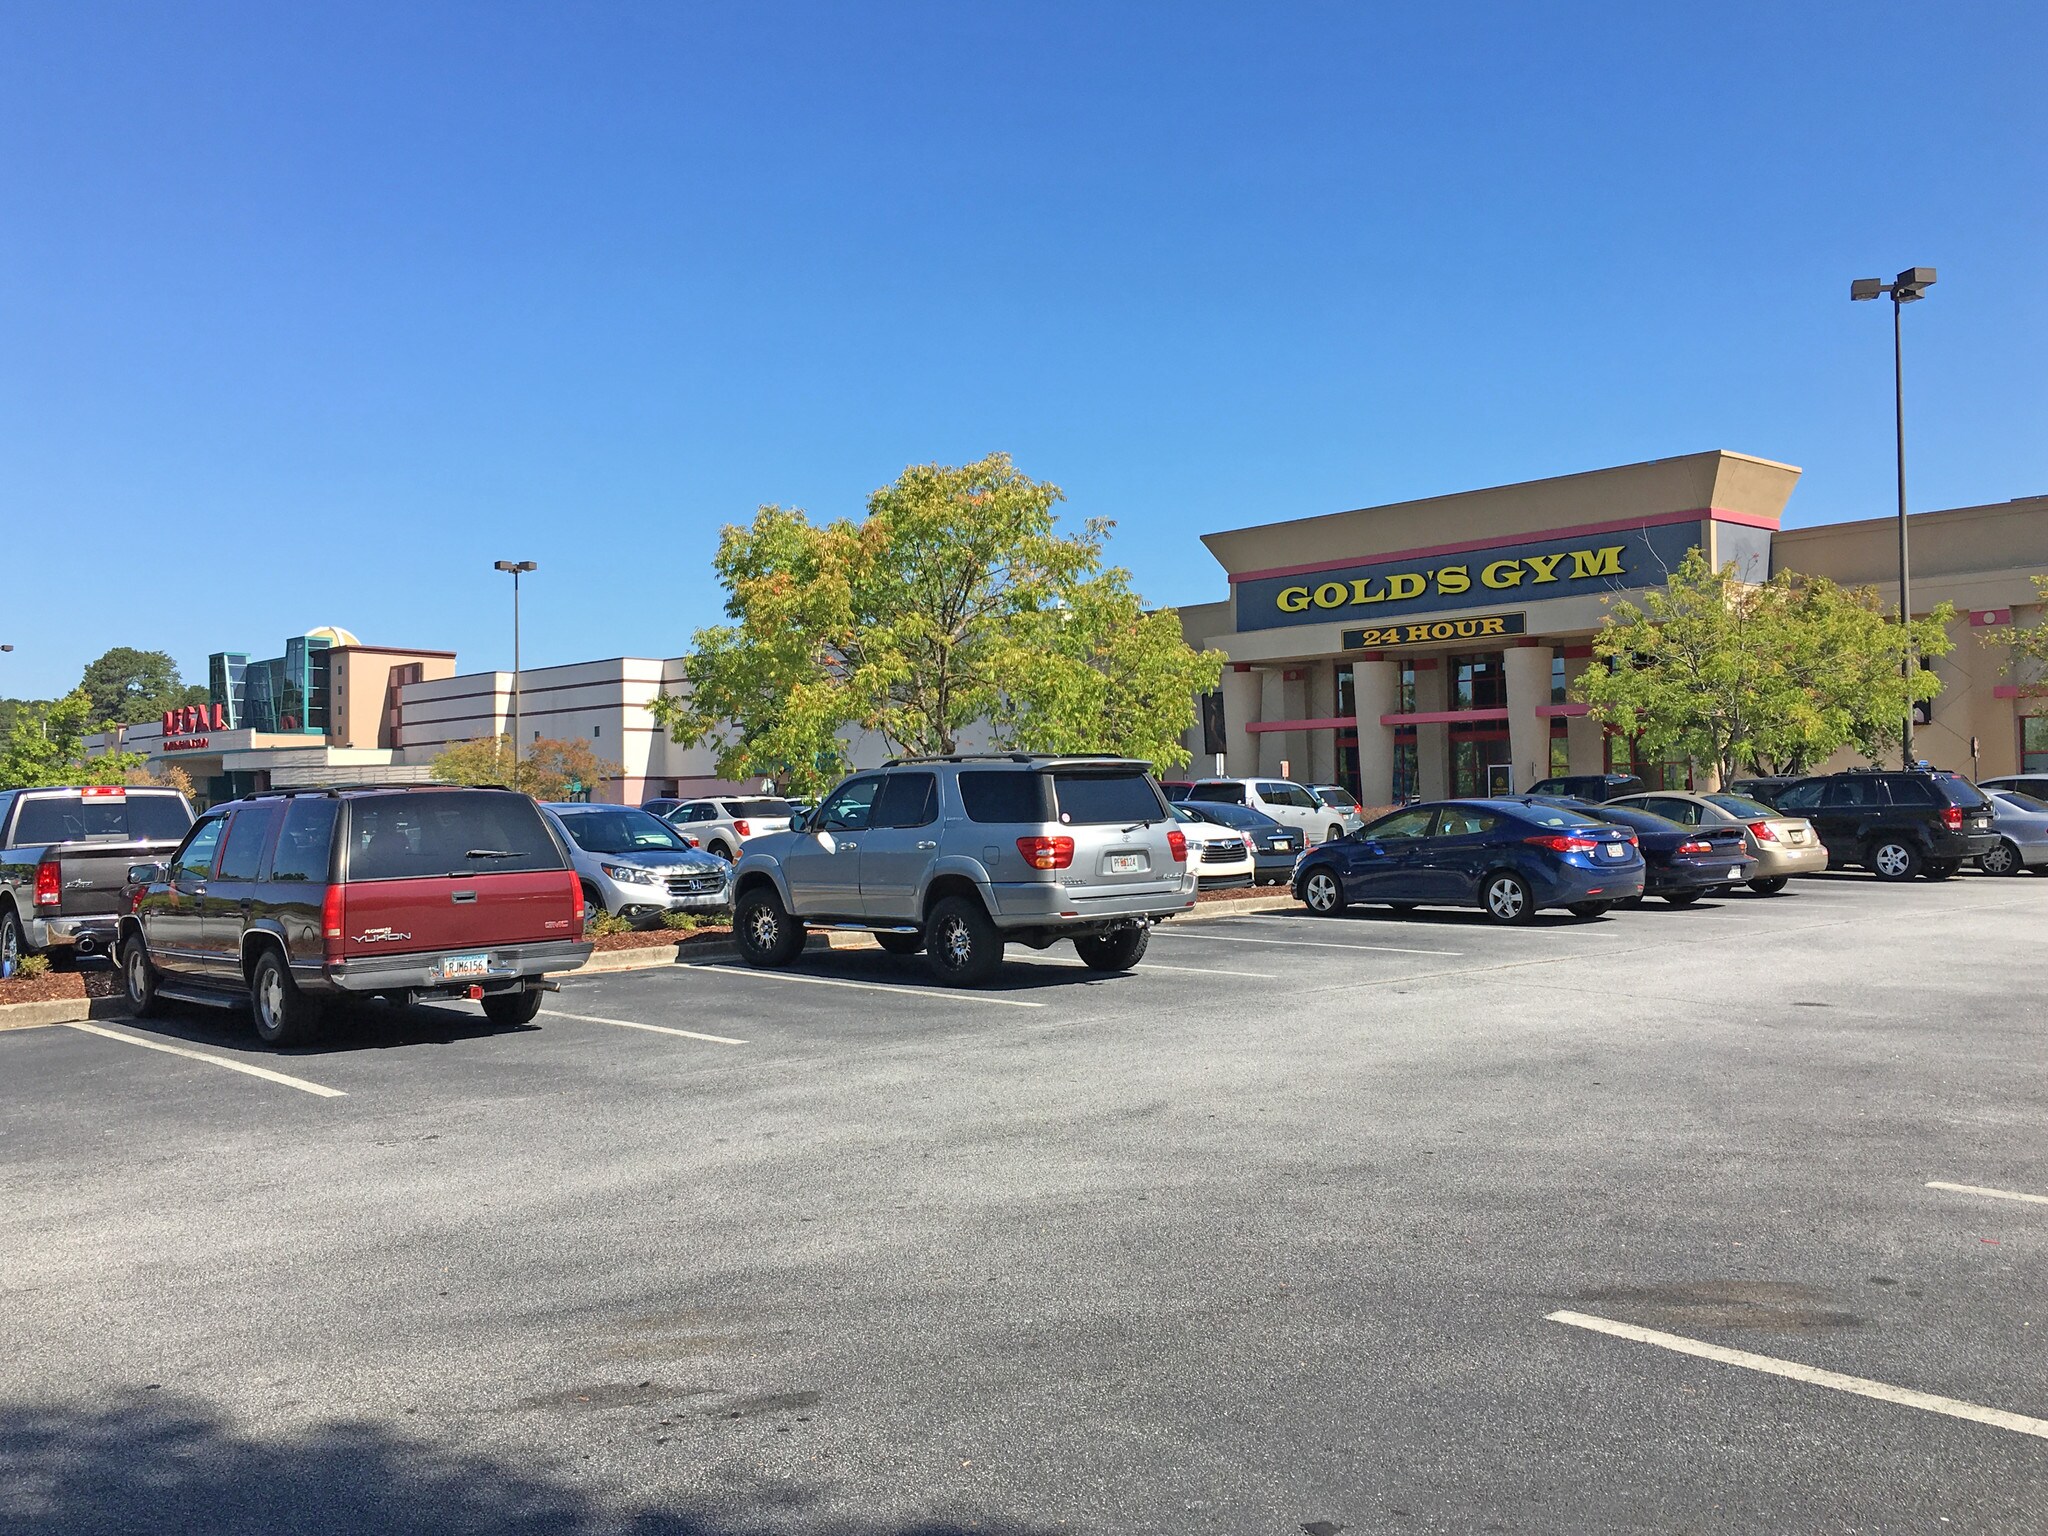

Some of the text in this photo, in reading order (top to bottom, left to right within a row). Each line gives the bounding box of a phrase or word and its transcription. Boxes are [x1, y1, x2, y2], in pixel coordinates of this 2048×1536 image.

[1276, 545, 1626, 612] GOLD'S GYM
[1362, 617, 1506, 646] 24 HOUR
[544, 920, 569, 929] GMC
[351, 932, 412, 944] YUKON
